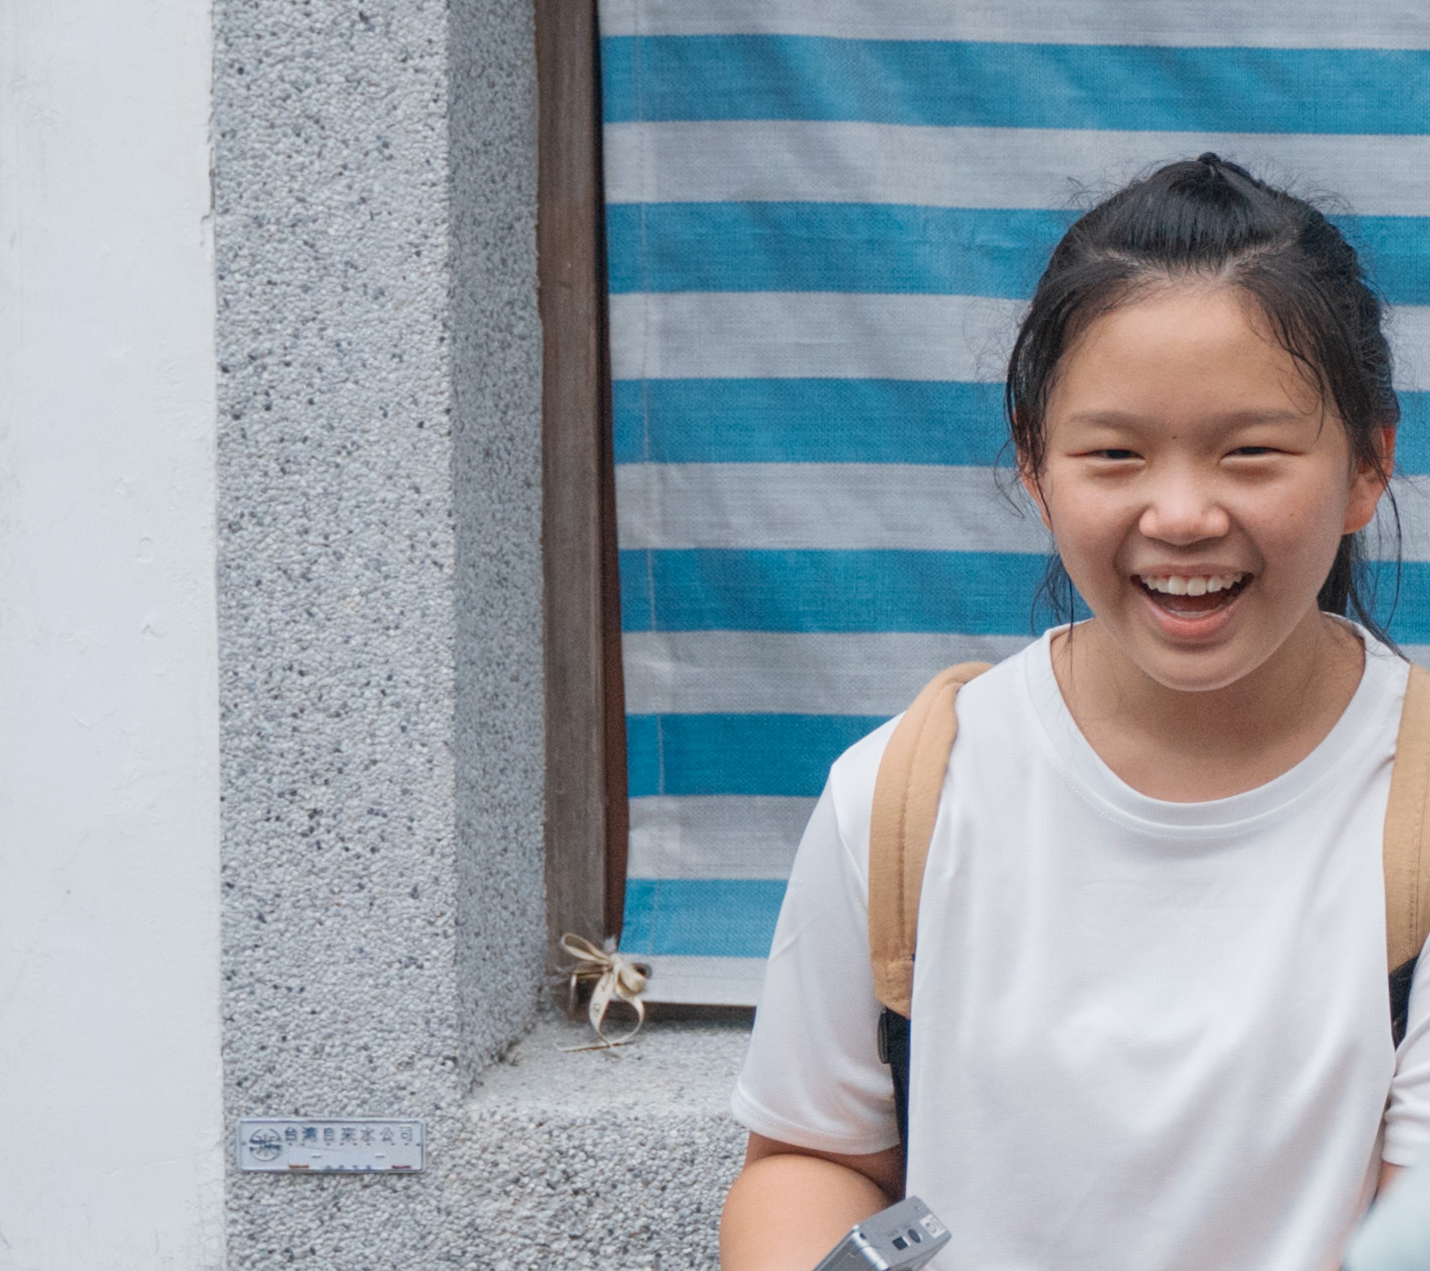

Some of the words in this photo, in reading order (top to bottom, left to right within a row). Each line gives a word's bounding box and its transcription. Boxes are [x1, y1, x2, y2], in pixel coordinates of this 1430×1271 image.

[285, 1126, 413, 1142] 台灣自來水公司
